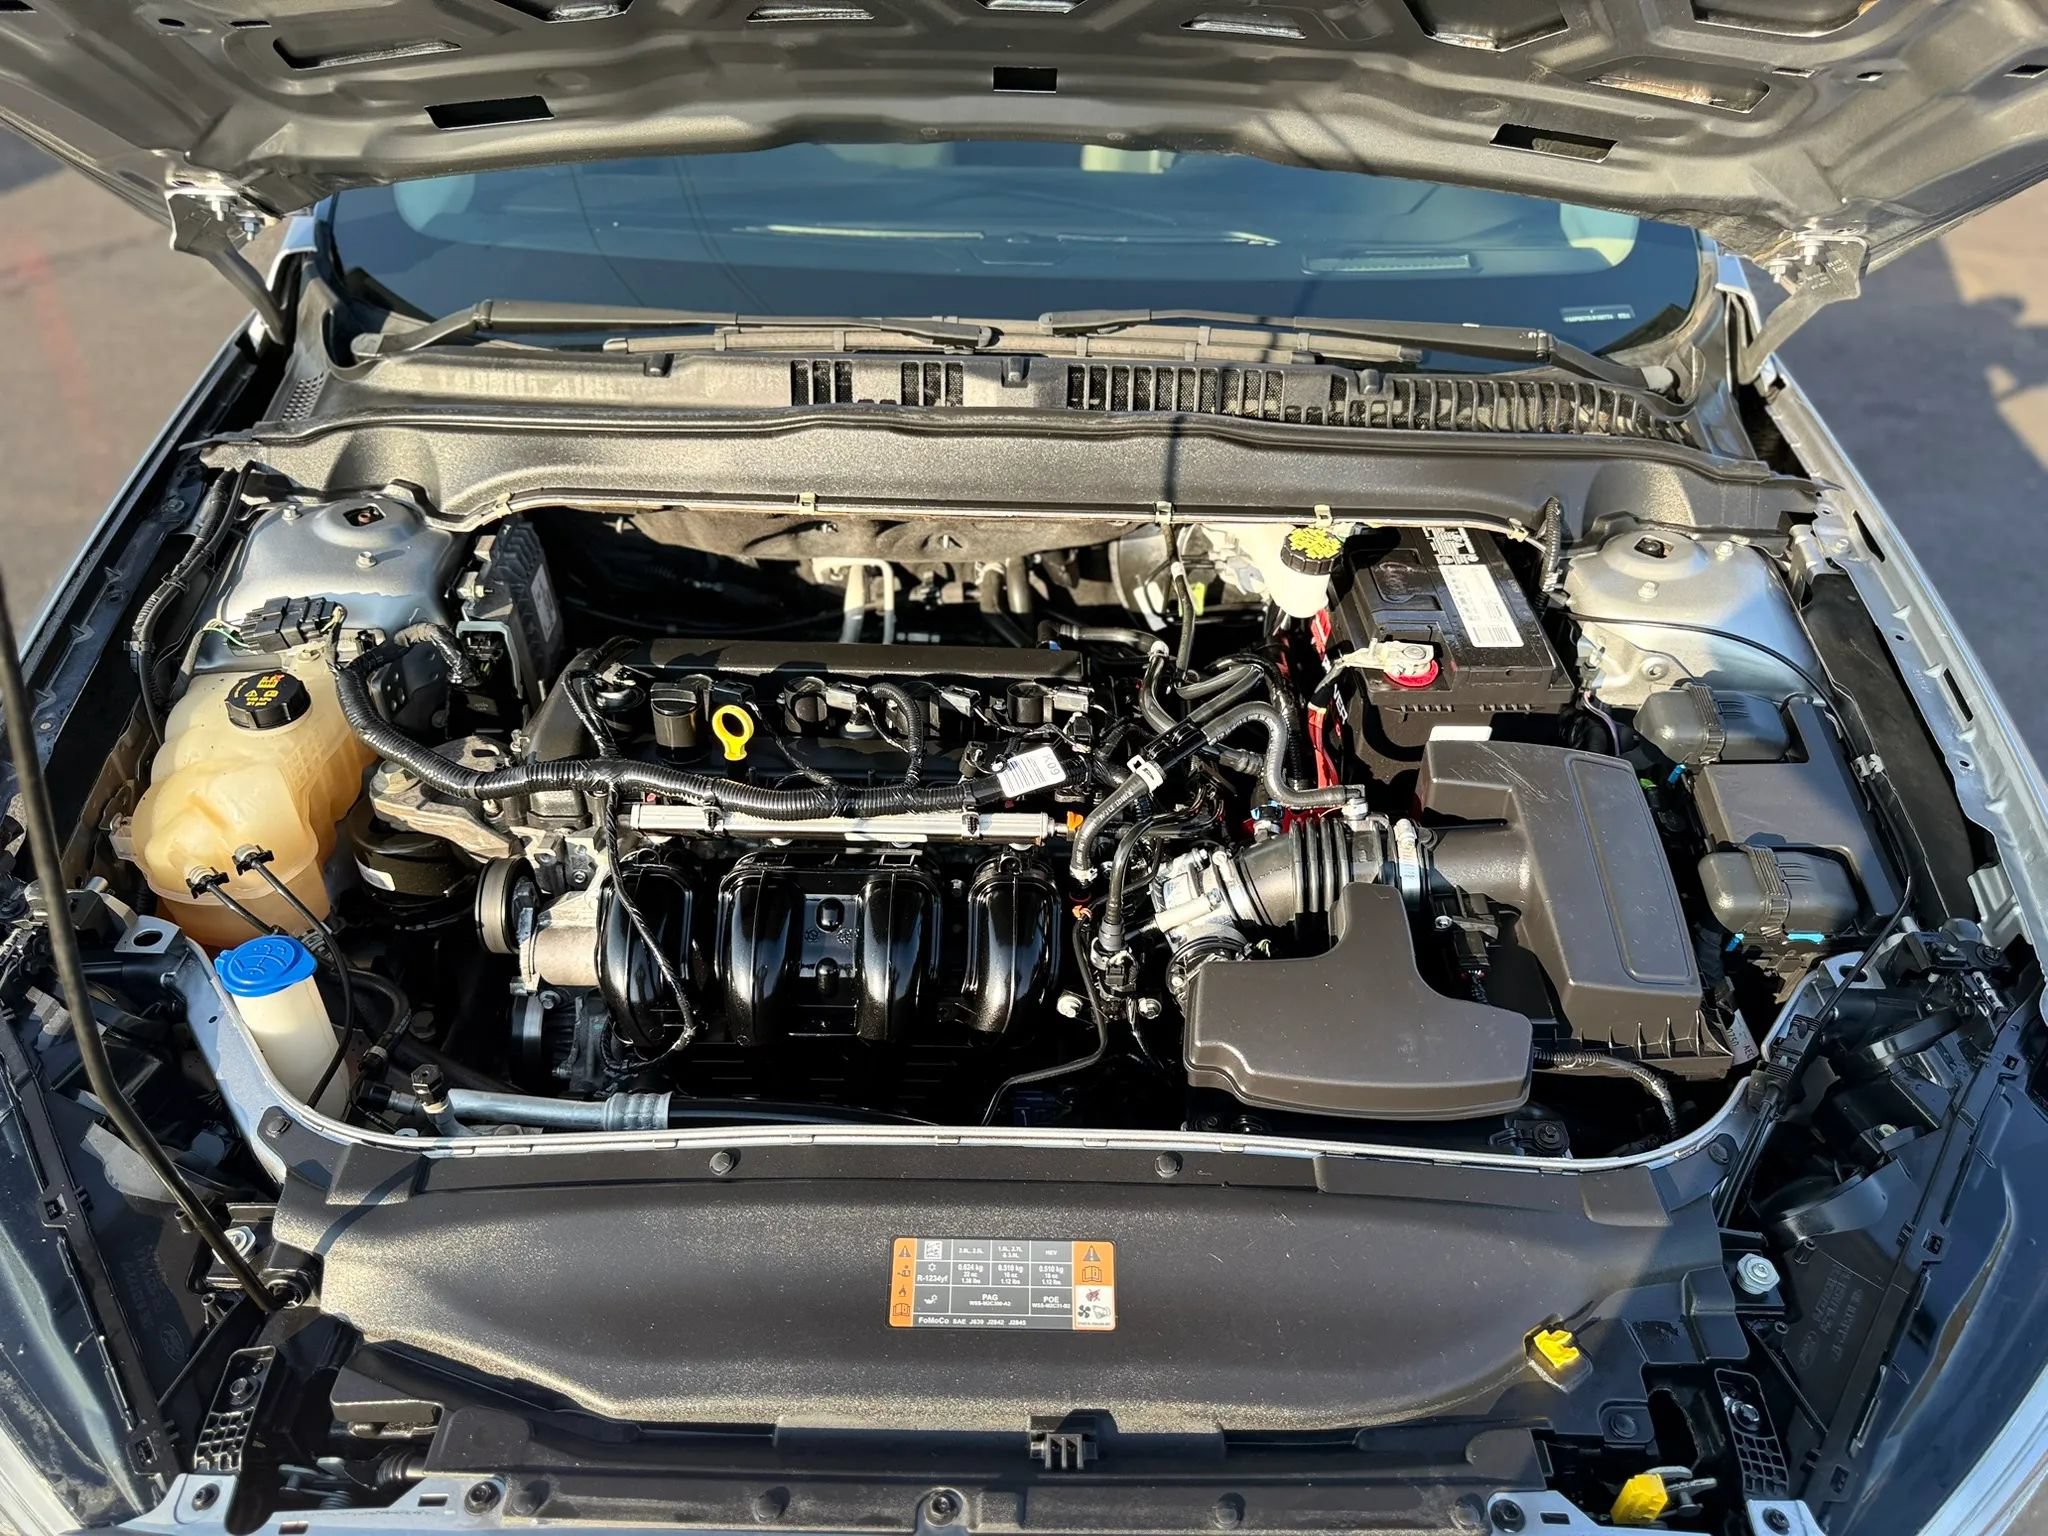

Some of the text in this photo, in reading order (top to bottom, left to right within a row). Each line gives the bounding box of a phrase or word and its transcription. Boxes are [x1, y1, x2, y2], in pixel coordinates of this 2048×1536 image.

[1744, 1044, 1755, 1060] AEC
[975, 1264, 984, 1272] kg
[1015, 1264, 1024, 1273] kg
[1056, 1265, 1064, 1274] kg
[917, 1274, 948, 1283] R-1234yf
[918, 1316, 950, 1325] FoMoCo
